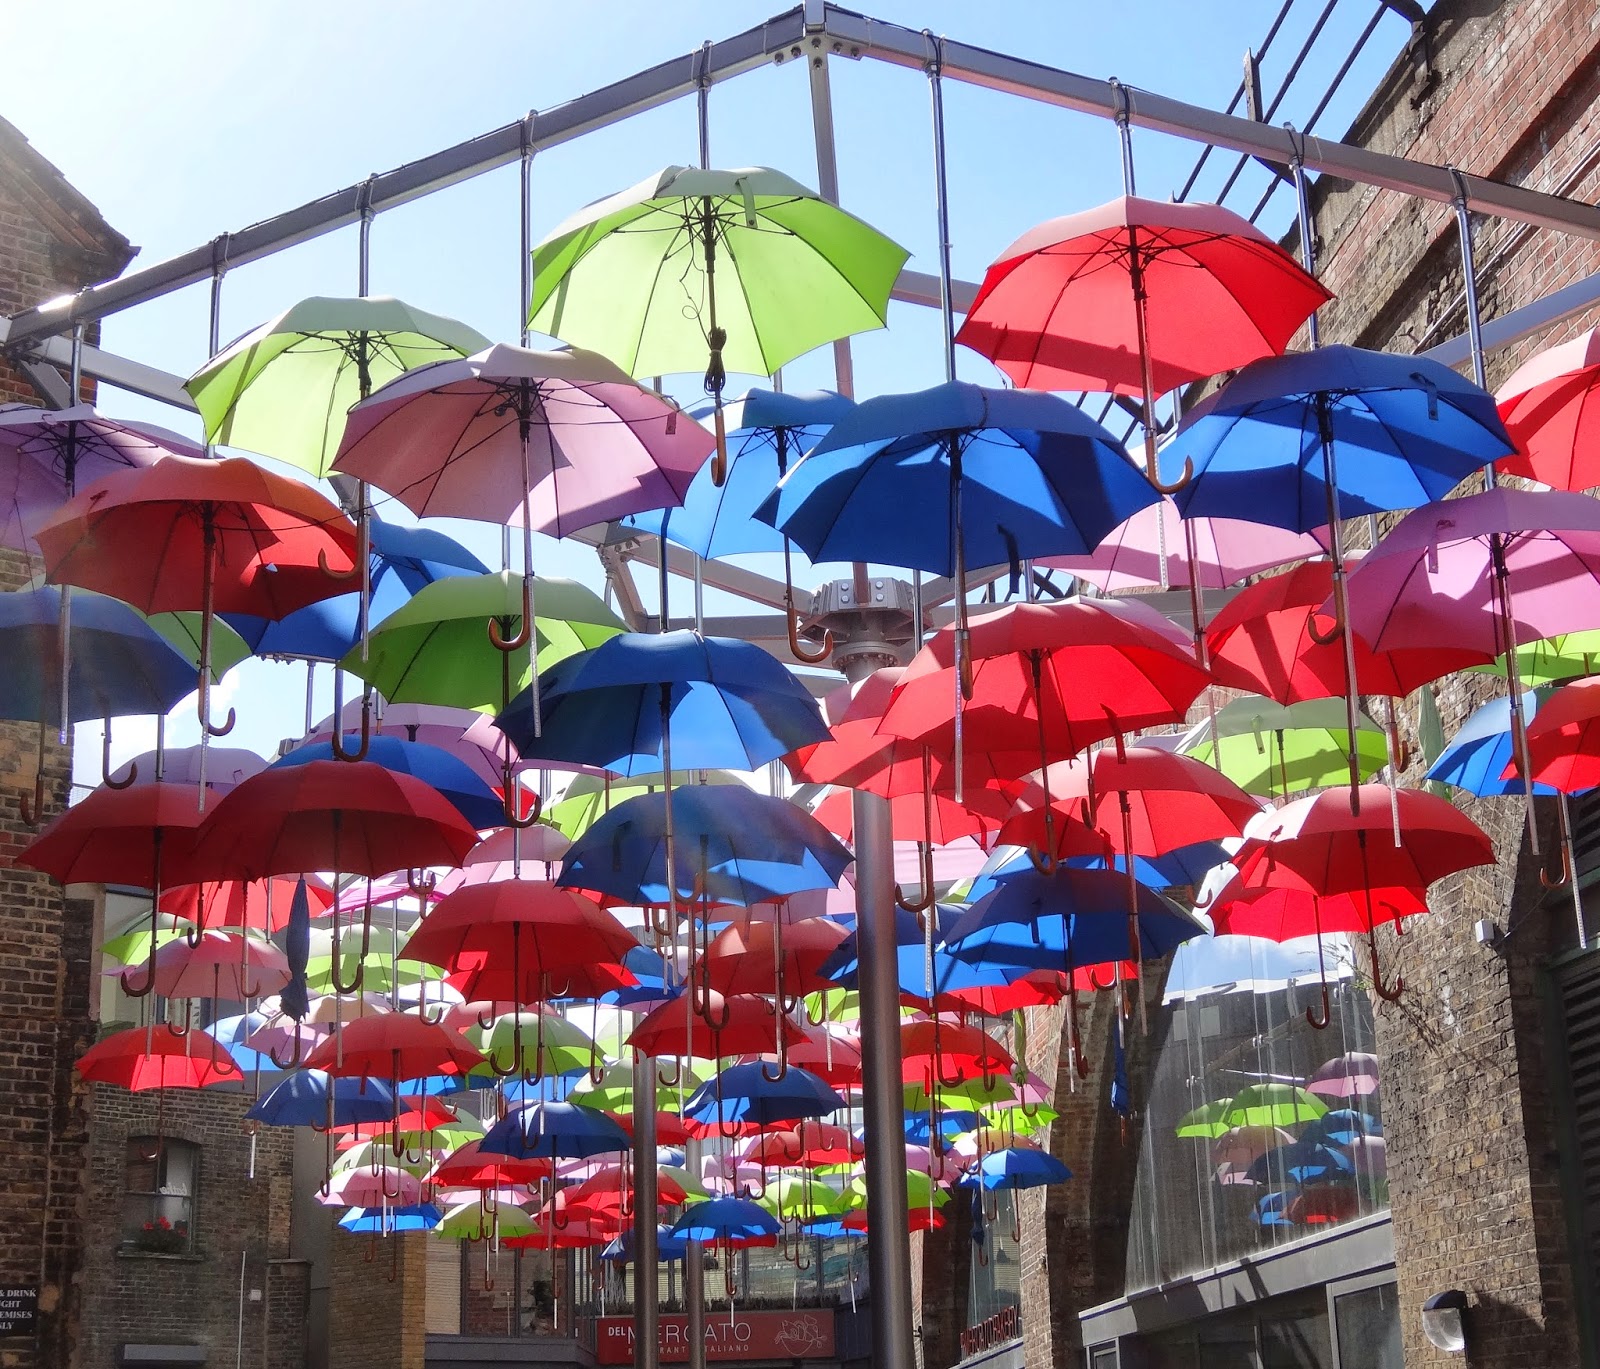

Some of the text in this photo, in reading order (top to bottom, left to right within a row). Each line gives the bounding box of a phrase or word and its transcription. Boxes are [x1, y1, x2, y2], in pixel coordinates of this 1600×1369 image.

[7, 1289, 36, 1297] DRINK
[0, 1300, 21, 1308] GHT
[608, 1326, 626, 1336] DEL
